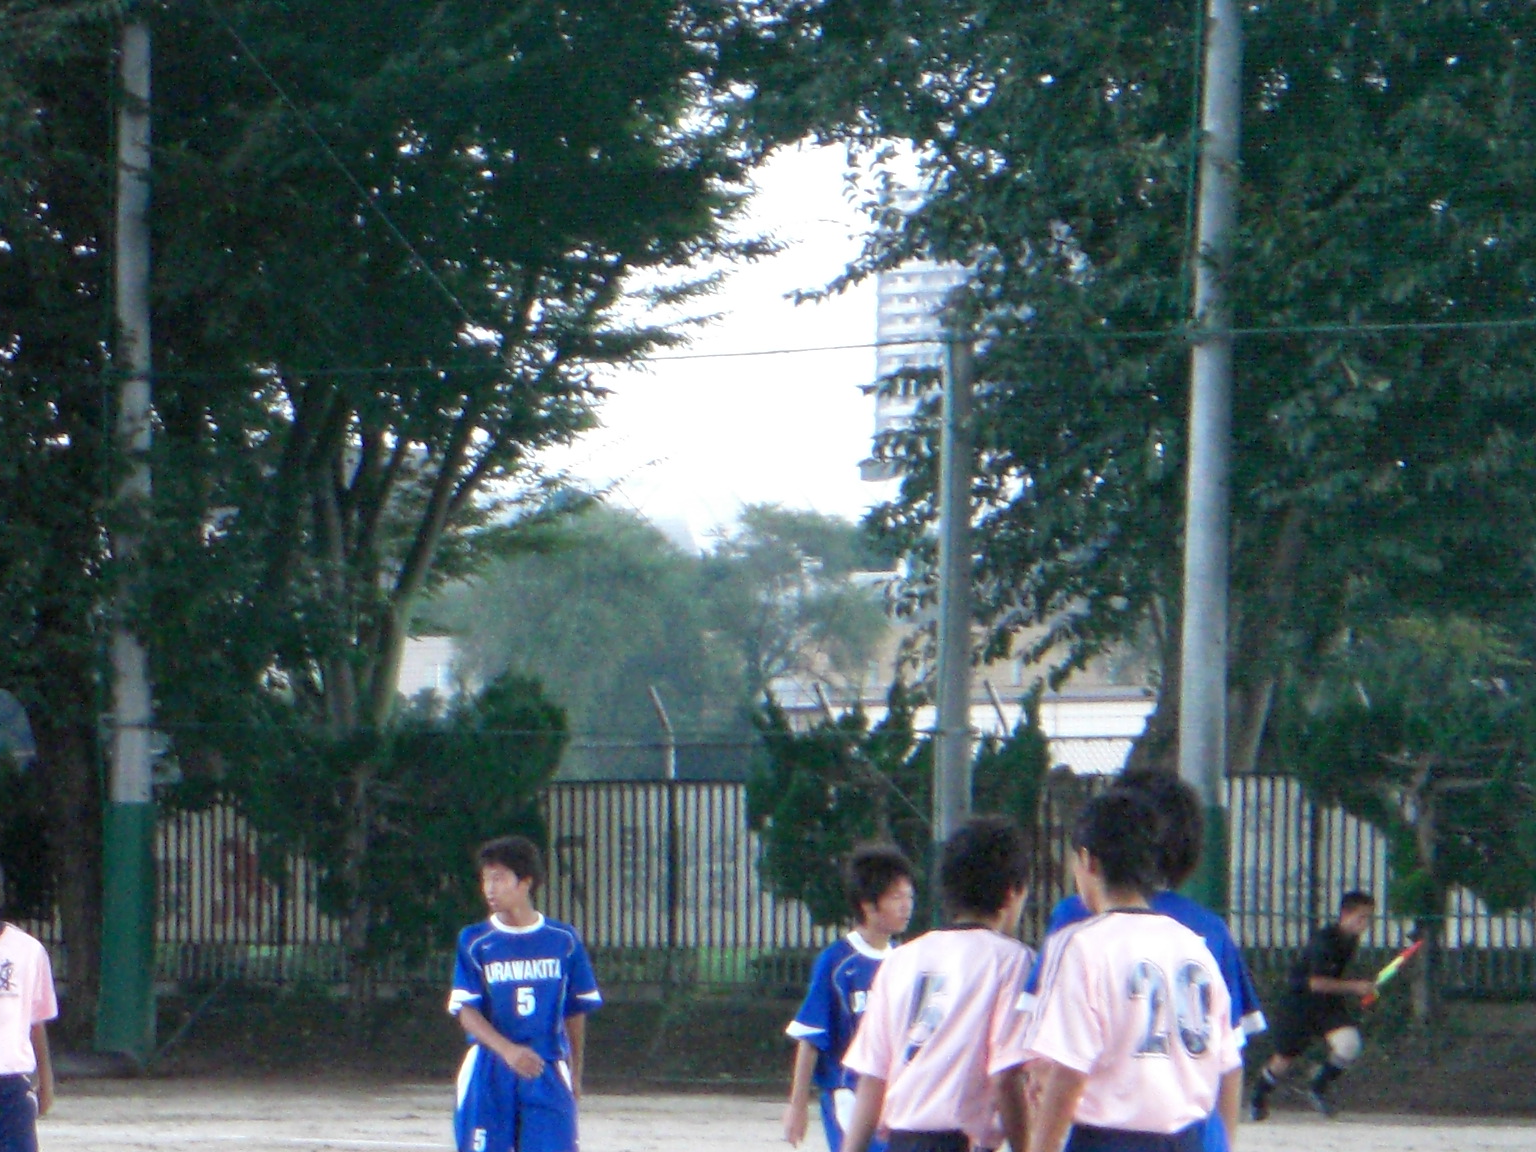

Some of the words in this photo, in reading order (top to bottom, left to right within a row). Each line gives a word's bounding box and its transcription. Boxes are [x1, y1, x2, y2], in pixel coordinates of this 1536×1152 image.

[484, 958, 562, 984] URAWAKITA
[516, 986, 536, 1017] 5
[1126, 957, 1213, 1060] 20
[473, 1127, 487, 1152] 5
